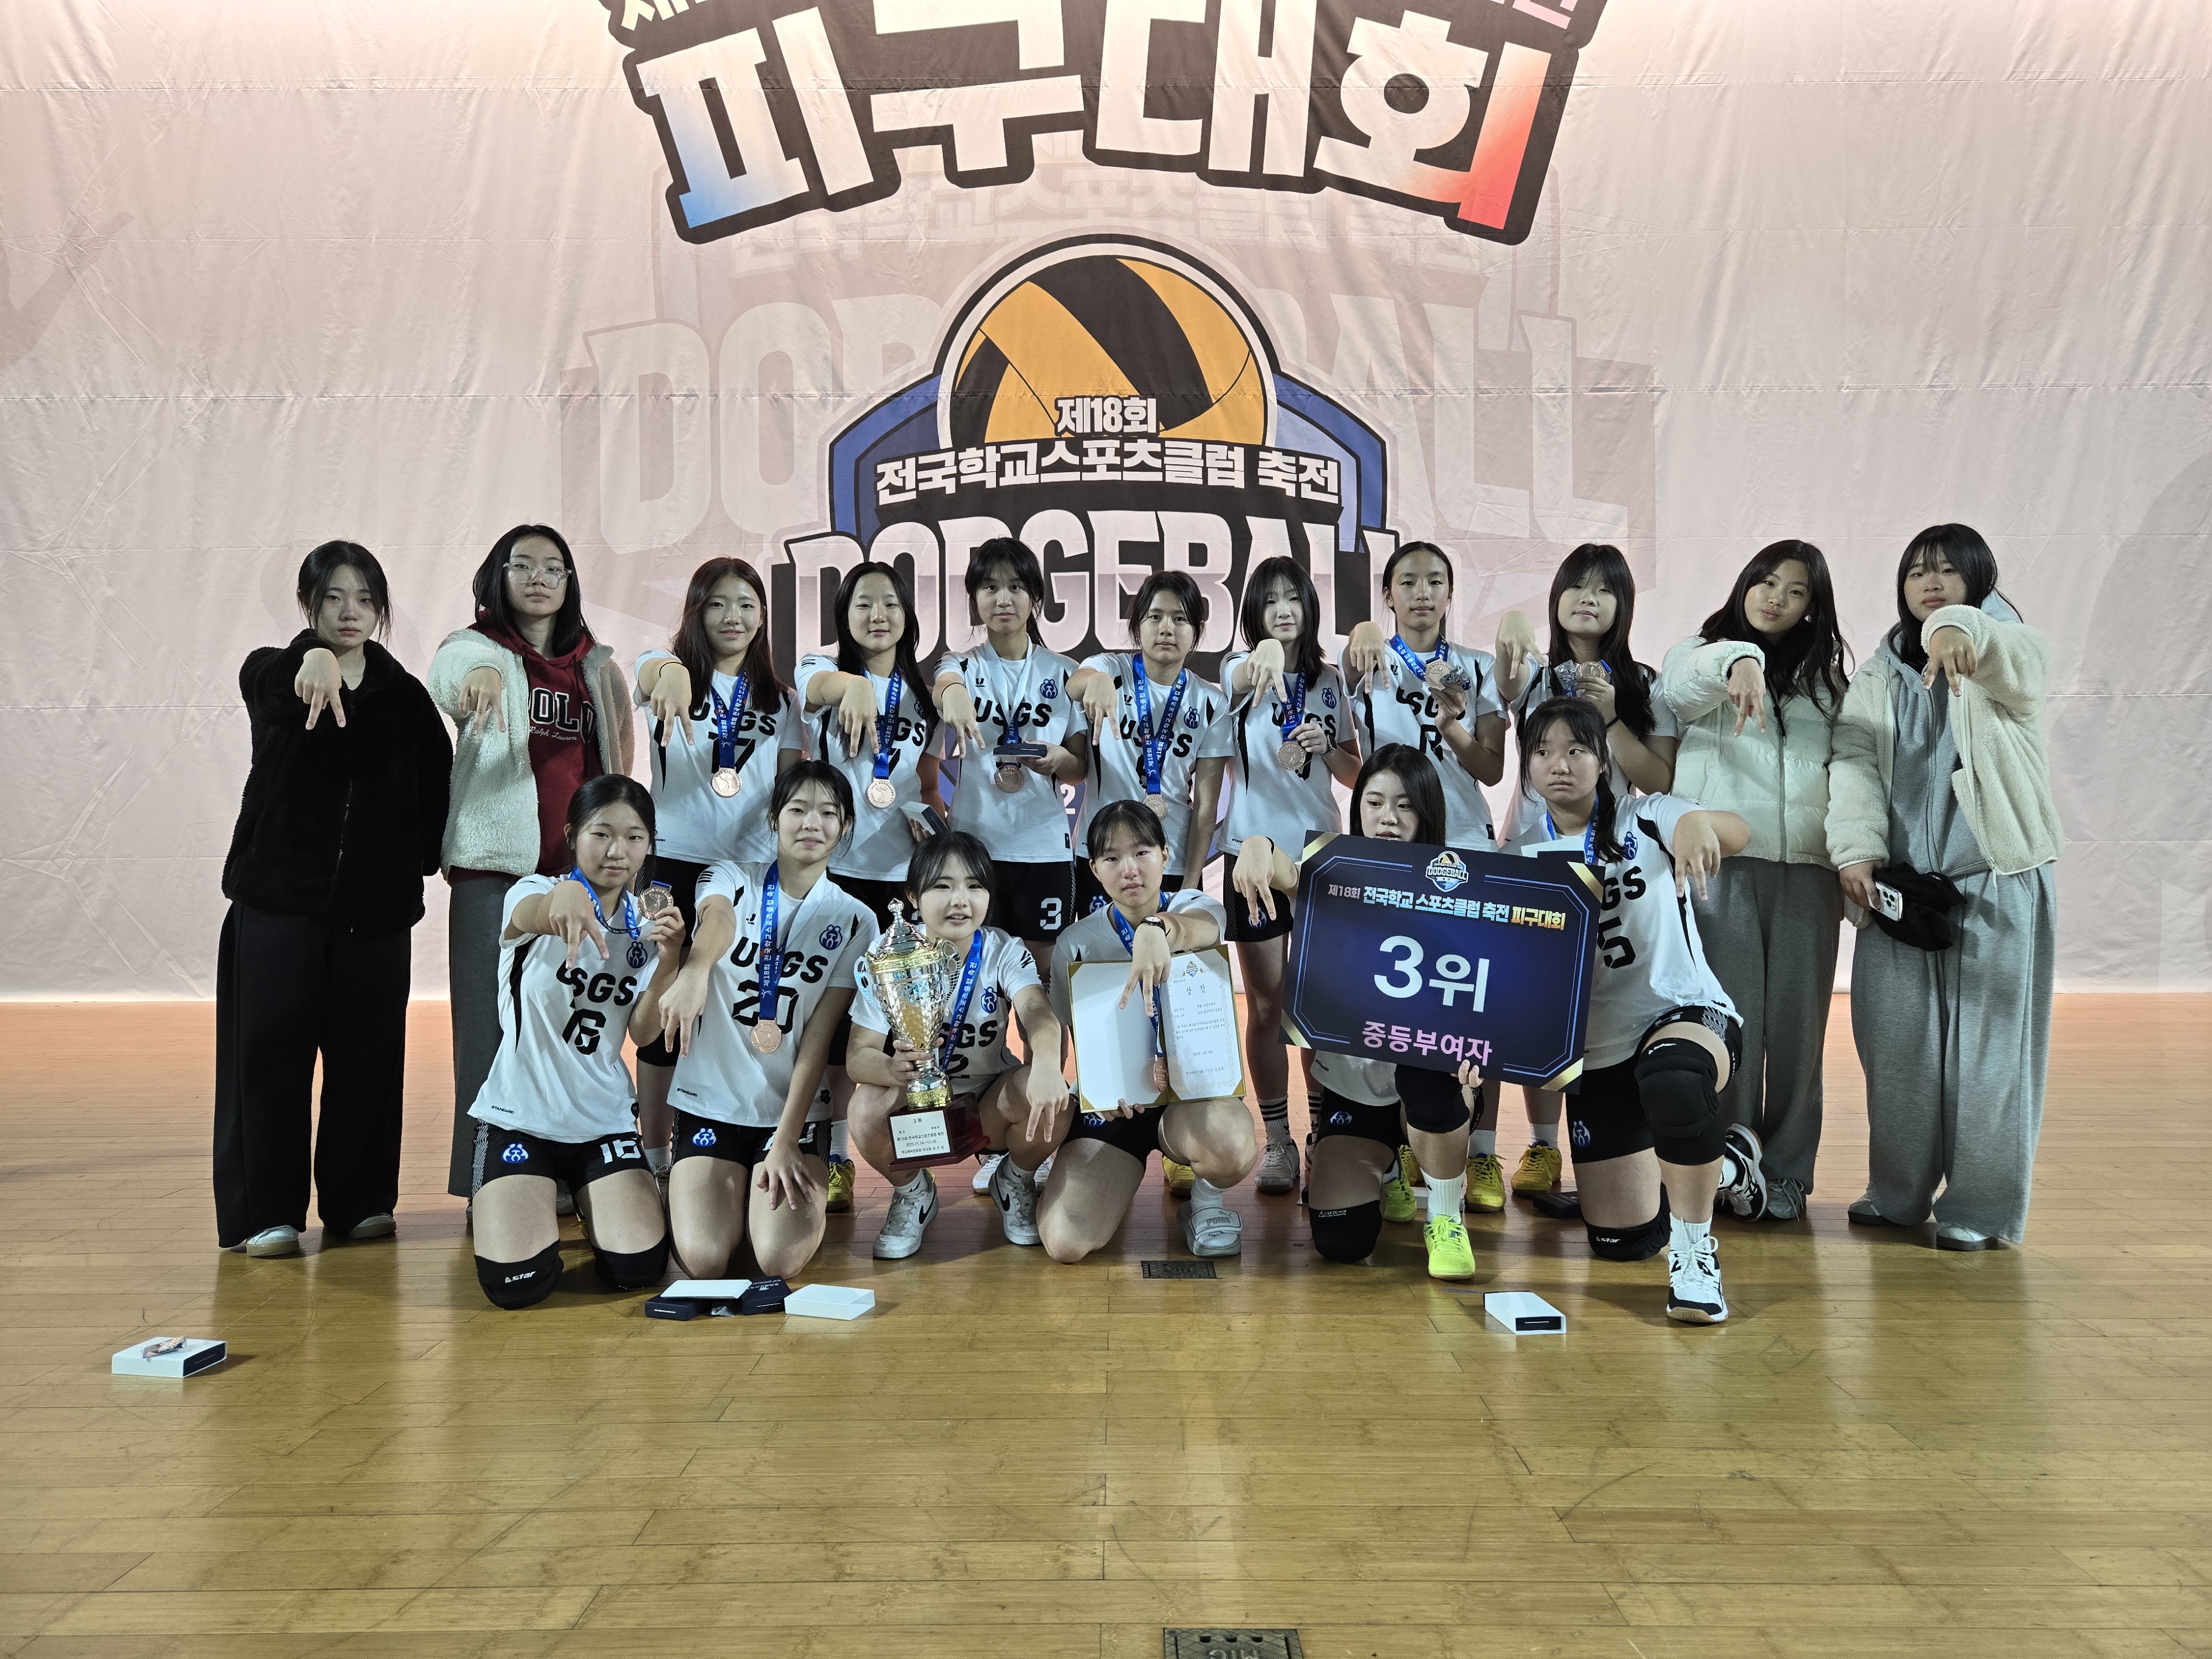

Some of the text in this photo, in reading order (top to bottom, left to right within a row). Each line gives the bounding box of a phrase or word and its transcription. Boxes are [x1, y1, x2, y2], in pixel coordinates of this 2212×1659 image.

[636, 0, 1552, 229] 피구대회
[1056, 396, 1157, 436] 제18회
[875, 438, 1341, 505] 전국학교스포츠클럽 축전
[1138, 679, 1144, 691] 축전
[529, 687, 597, 744] OLO
[529, 726, 577, 740] Ralph Lauren
[690, 702, 777, 736] UGS
[1119, 714, 1193, 758] US
[1139, 692, 1152, 745] 전국학교스포츠클럽
[1160, 690, 1180, 740] 전국학교스포츠클럽
[1146, 747, 1154, 766] 제18회
[767, 884, 774, 897] 축전
[1428, 867, 1466, 880] DODGEBALL
[1601, 865, 1646, 911] GS
[1040, 898, 1062, 930] 3
[1328, 884, 1566, 931] 제18회 전국학교 스포츠클럽 축전 피구대회
[764, 899, 774, 961] 전국학교스포츠클럽
[731, 936, 828, 984] UGS
[1374, 935, 1490, 1012] 3위
[950, 977, 973, 1042] 전국학교스포츠클럽
[967, 961, 977, 975] 축전
[938, 1020, 998, 1048] SGS
[492, 1105, 514, 1114] STANDARD
[600, 1138, 641, 1164] 16
[1206, 1216, 1231, 1227] PUMA
